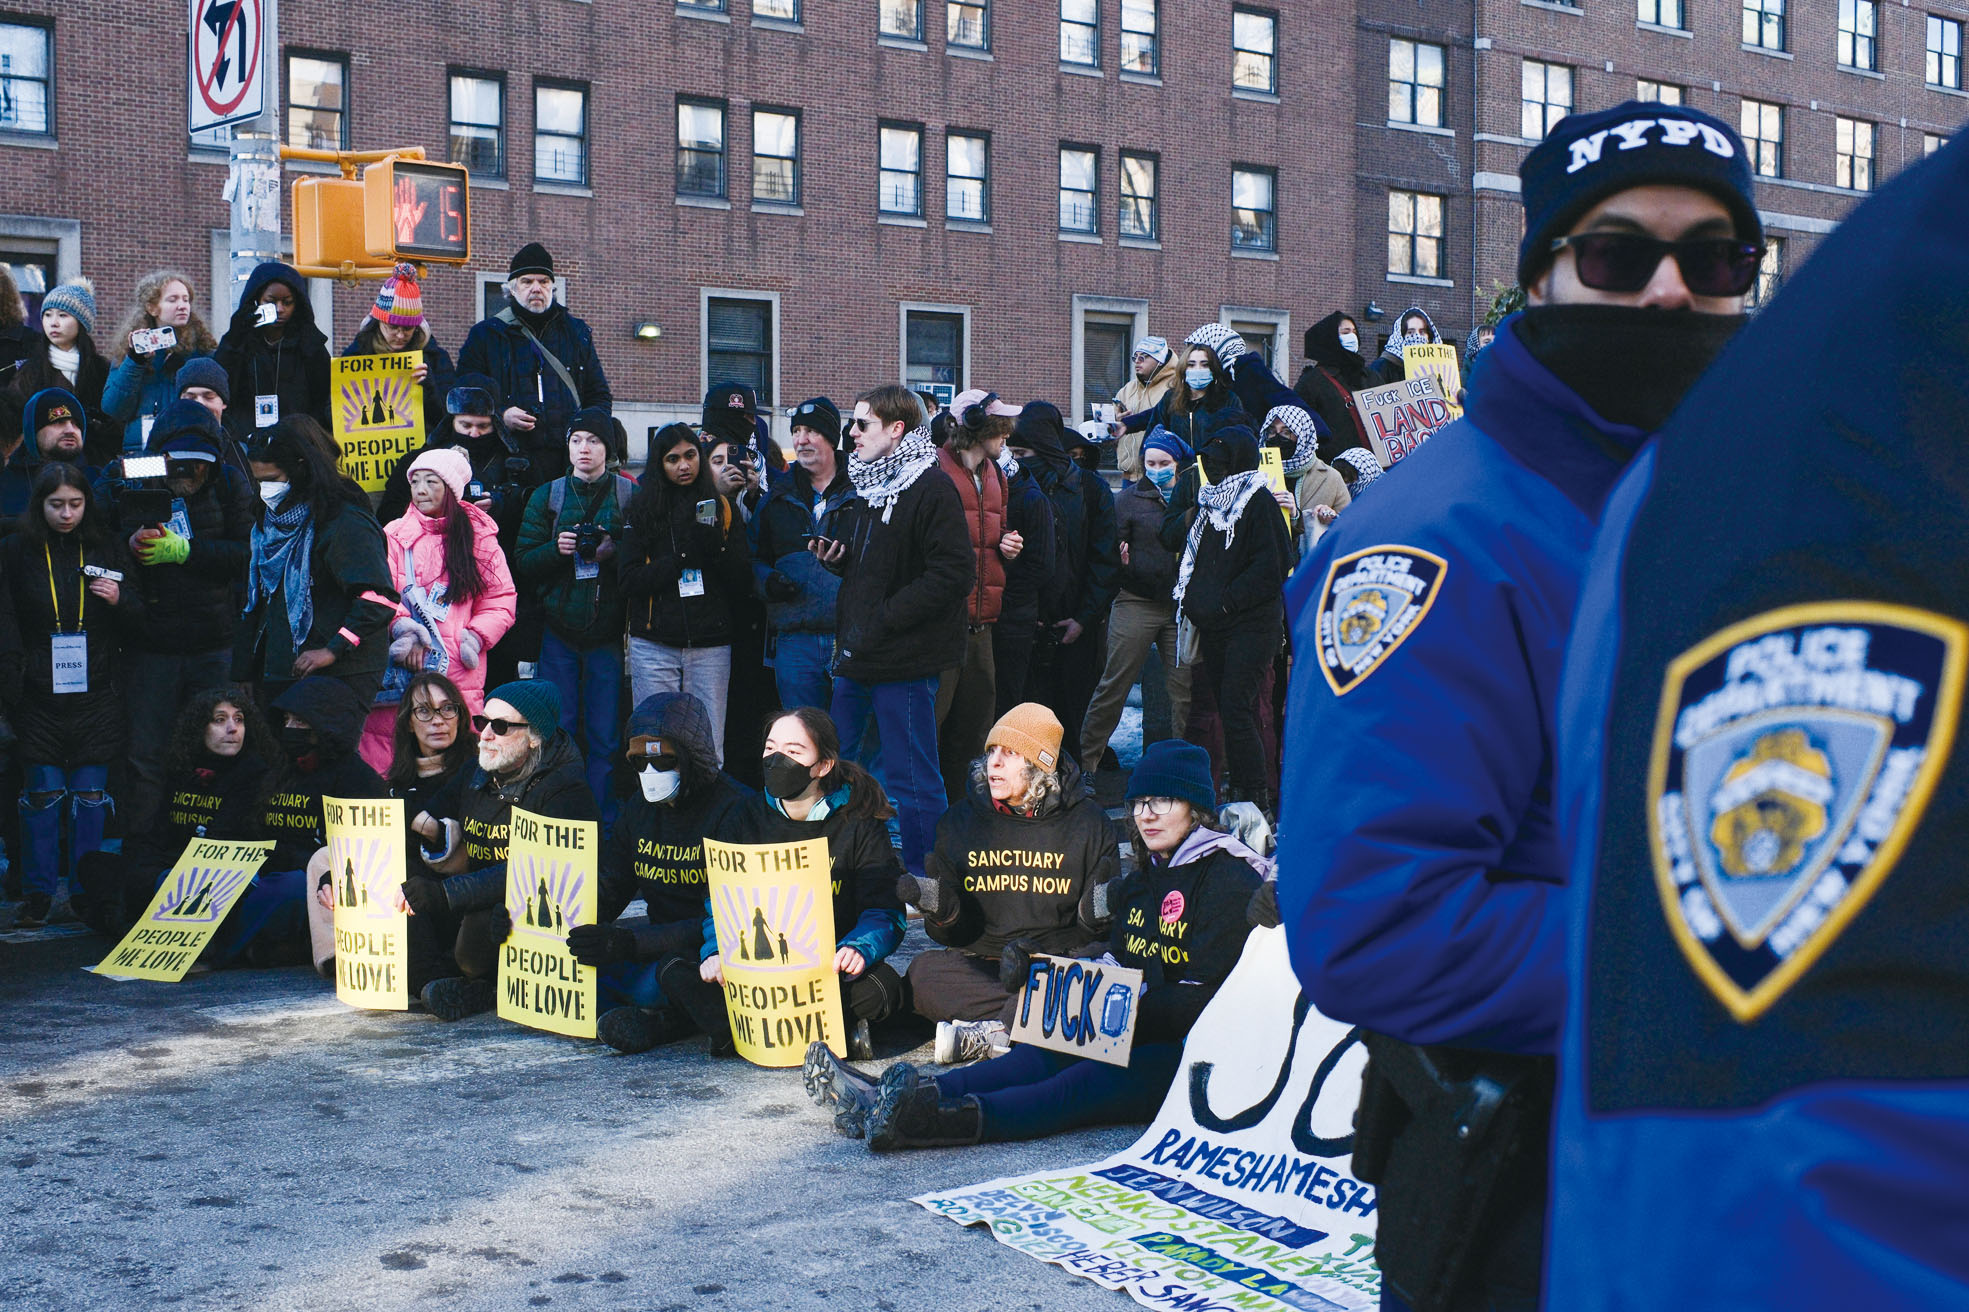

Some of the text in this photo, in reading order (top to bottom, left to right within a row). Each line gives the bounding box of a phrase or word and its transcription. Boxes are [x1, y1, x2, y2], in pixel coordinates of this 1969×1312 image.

[1566, 118, 1734, 174] NYPD
[440, 186, 463, 241] 15
[340, 356, 413, 373] FOR THE
[1410, 346, 1454, 359] FOR THE
[1405, 378, 1433, 398] ICE
[1370, 398, 1450, 441] LAND
[344, 437, 415, 458] PEOPLE
[1383, 424, 1449, 464] BA
[345, 458, 401, 481] WE LO
[56, 661, 83, 669] PRESS
[286, 814, 318, 829] NOW
[326, 803, 391, 827] FOR THE
[514, 815, 585, 850] FOR THE
[193, 843, 265, 862] FOR THE
[709, 847, 747, 873] FOR
[755, 846, 809, 872] THE
[968, 850, 1064, 869] SANCTUARY
[634, 861, 678, 884] CAMPUS
[964, 875, 1071, 894] CAMPUS NOW
[132, 929, 206, 947] PEOPLE
[336, 928, 395, 956] PEOPLE
[113, 948, 191, 971] WE LOVE
[506, 945, 583, 984] PEOPLE
[338, 957, 396, 993] WE LOVE
[507, 976, 585, 1020] WE LOVE
[727, 979, 824, 1010] PEOPLE
[1020, 958, 1104, 1046] FUCK
[733, 1010, 829, 1048] WE LOVE
[1052, 1249, 1160, 1283] HEBER
